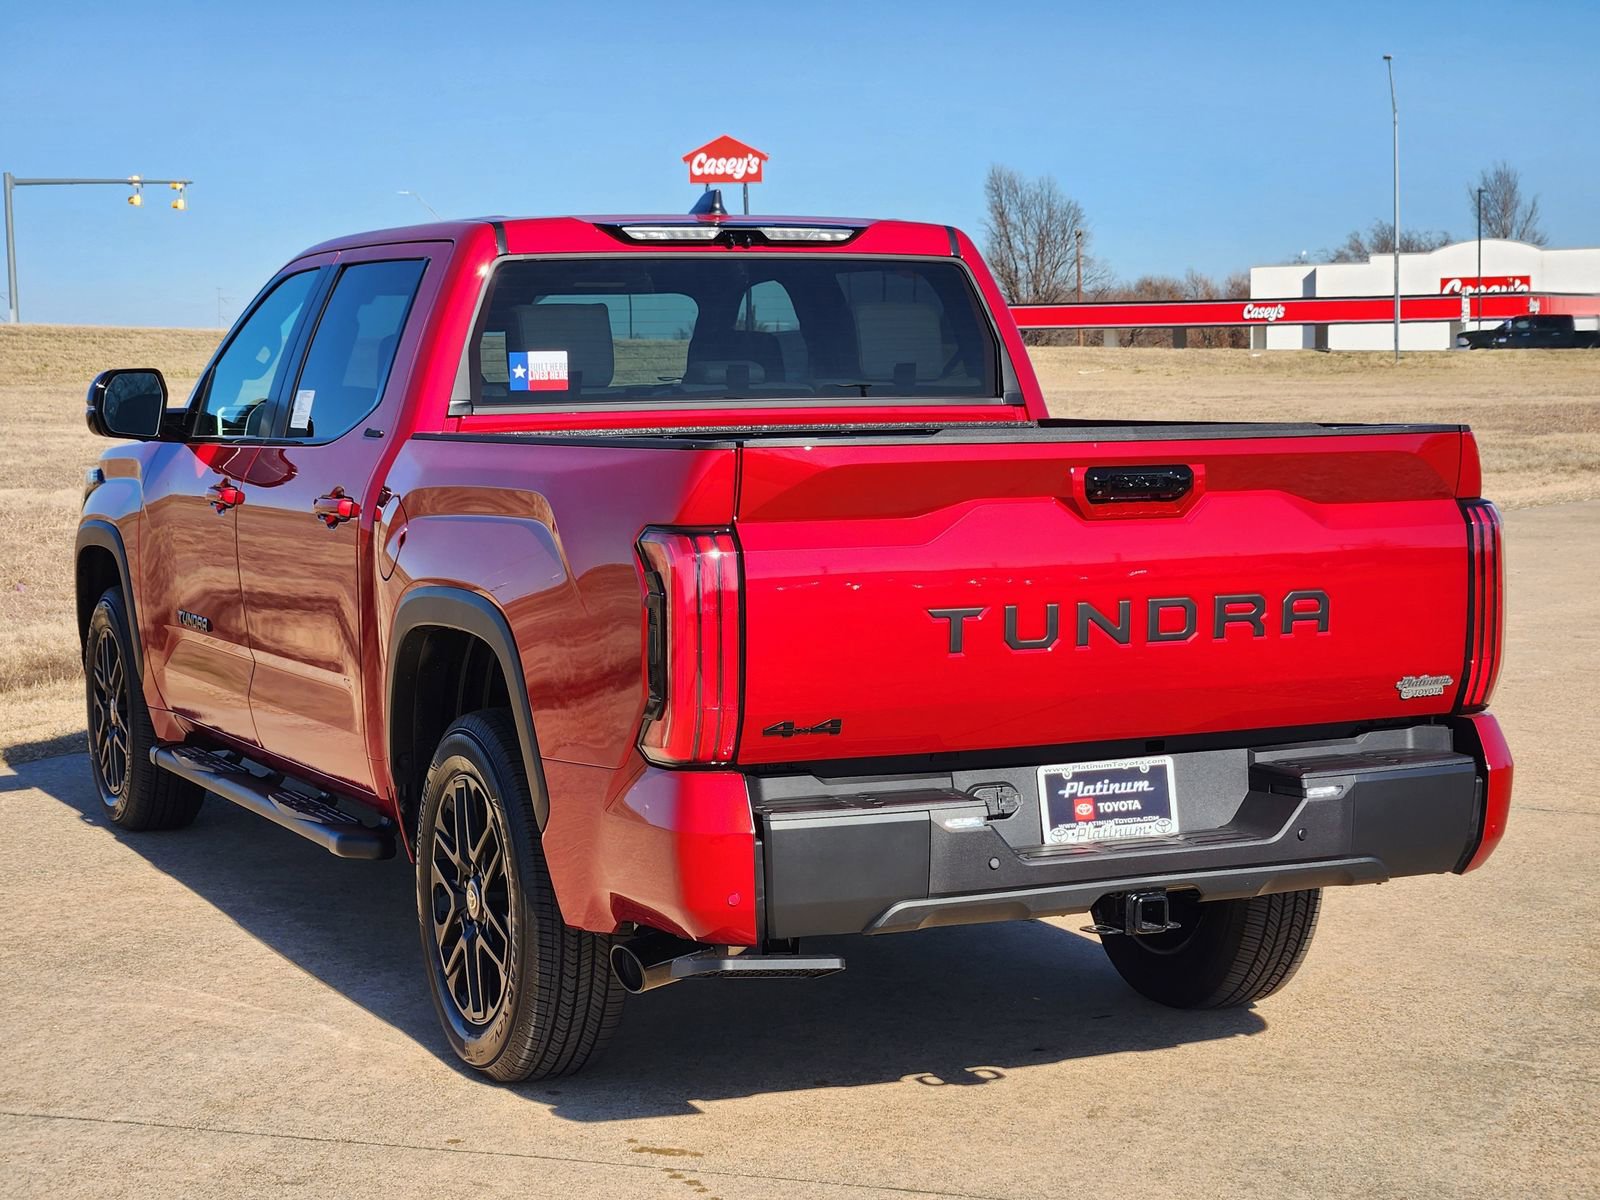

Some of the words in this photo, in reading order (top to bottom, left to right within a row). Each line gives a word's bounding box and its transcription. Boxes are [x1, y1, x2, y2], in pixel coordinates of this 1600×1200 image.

[691, 152, 760, 180] Casey's
[1243, 303, 1286, 322] Casey's
[177, 609, 209, 632] TUNDRA
[927, 589, 1331, 656] TUNDRA
[1398, 676, 1452, 689] Platinum
[1413, 686, 1443, 696] TOYOTA
[1044, 758, 1167, 773] www.PlatinumToyota.com
[1058, 779, 1154, 798] Platinum
[1097, 799, 1142, 813] TOYOTA
[1075, 822, 1152, 841] Platinum
